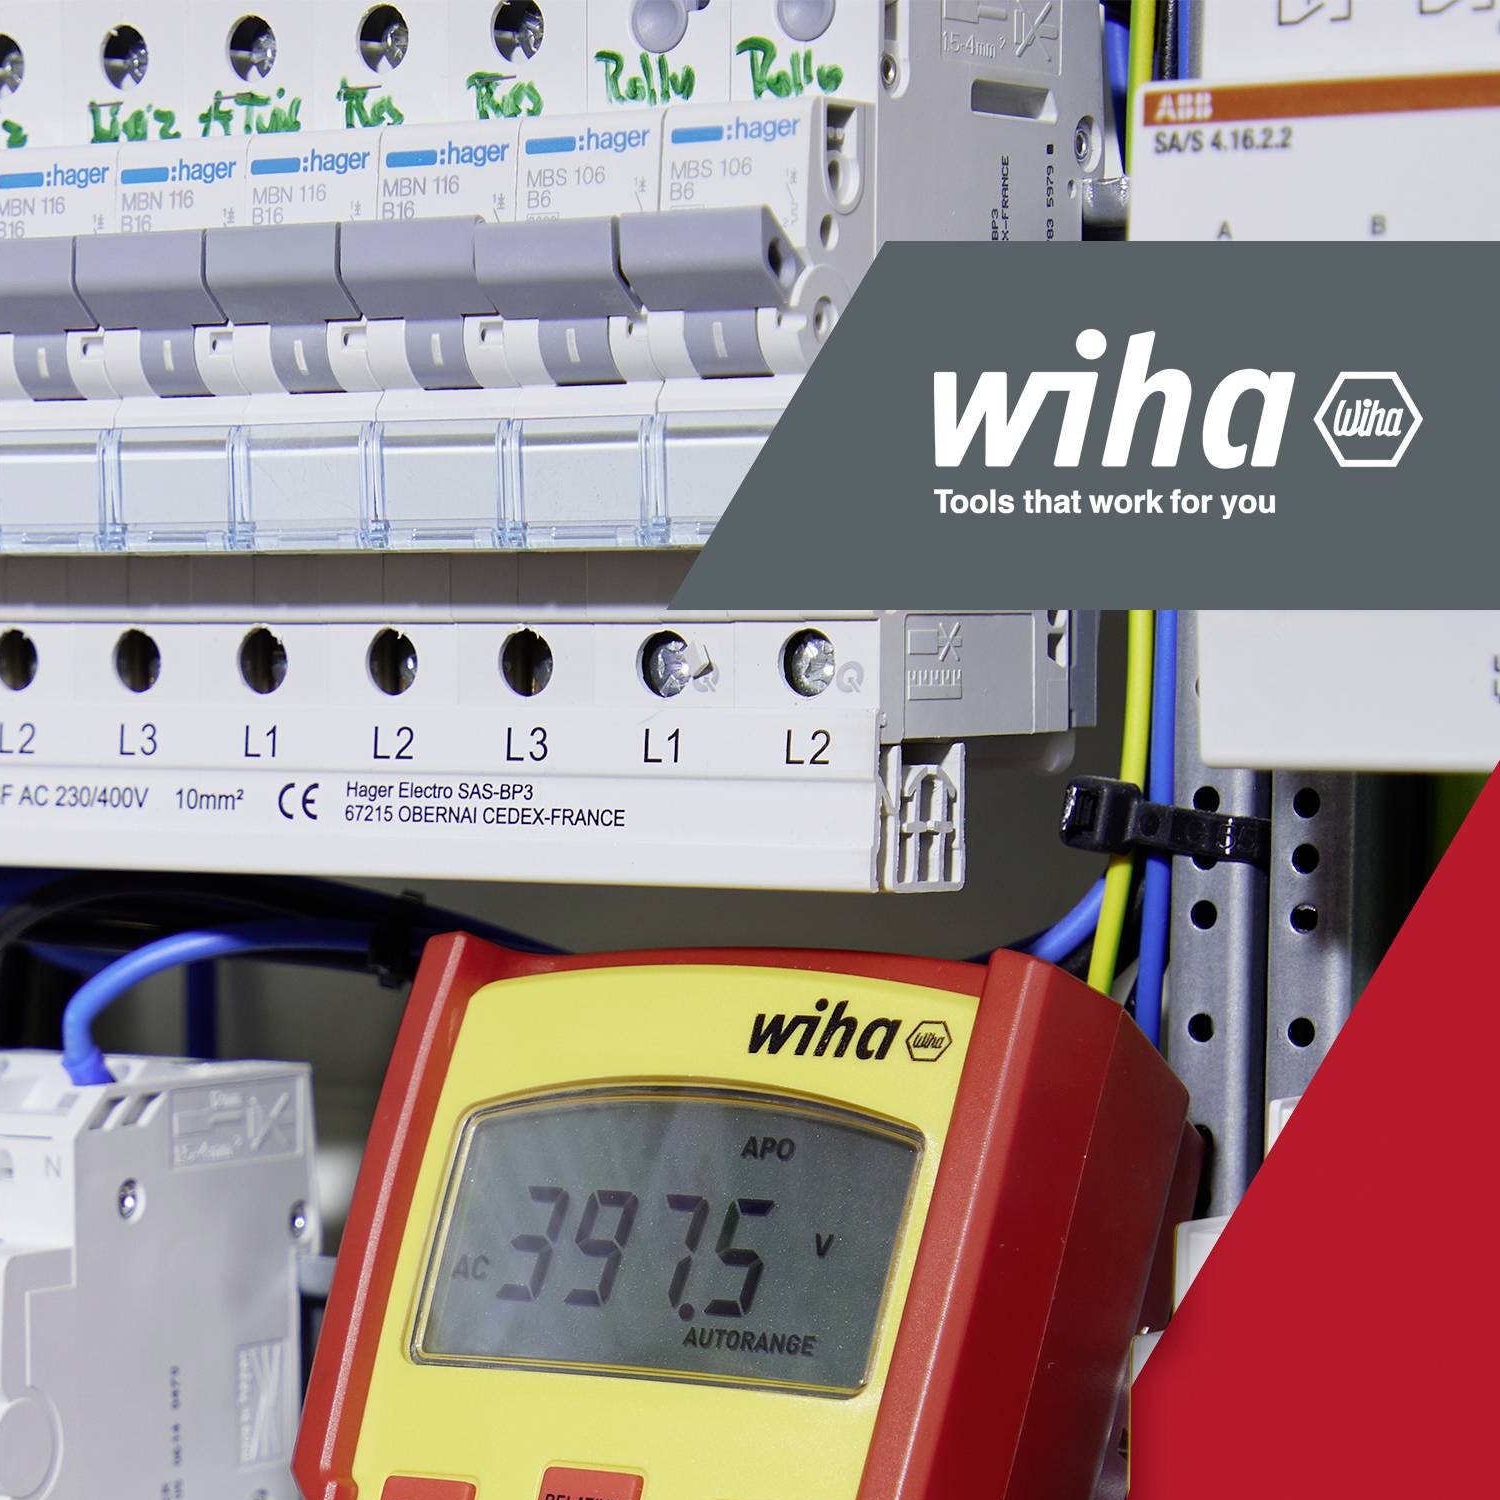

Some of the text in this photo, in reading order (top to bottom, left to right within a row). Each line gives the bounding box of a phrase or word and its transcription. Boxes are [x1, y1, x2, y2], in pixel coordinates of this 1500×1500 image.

[1155, 91, 1213, 121] ABB
[1154, 127, 1293, 154] SA/S 4.16.2.2
[527, 166, 606, 188] MBS 106
[671, 157, 753, 179] MBS 106
[253, 184, 327, 204] MBN 116
[382, 175, 460, 198] MBN 116
[670, 182, 695, 201] B6
[42, 196, 65, 215] 116
[121, 190, 194, 212] MBN 116
[527, 190, 552, 209] B6
[1217, 220, 1232, 240] A
[1371, 215, 1386, 235] B
[119, 723, 157, 756] L3
[244, 724, 278, 758] L1
[373, 725, 414, 760] L2
[506, 726, 549, 762] L3
[643, 727, 681, 764] L1
[785, 728, 832, 765] L2
[18, 785, 49, 807] AC
[55, 785, 149, 809] 230/400V
[346, 781, 534, 802] Hager Electro SAS-BP3
[344, 804, 626, 828] 67215 OBERNAI CEDEX-FRANCE
[748, 998, 902, 1060] wiha
[741, 1136, 796, 1163] APO
[452, 1185, 834, 1322] AC 397.5 V
[682, 1330, 817, 1357] AUTORANGE
